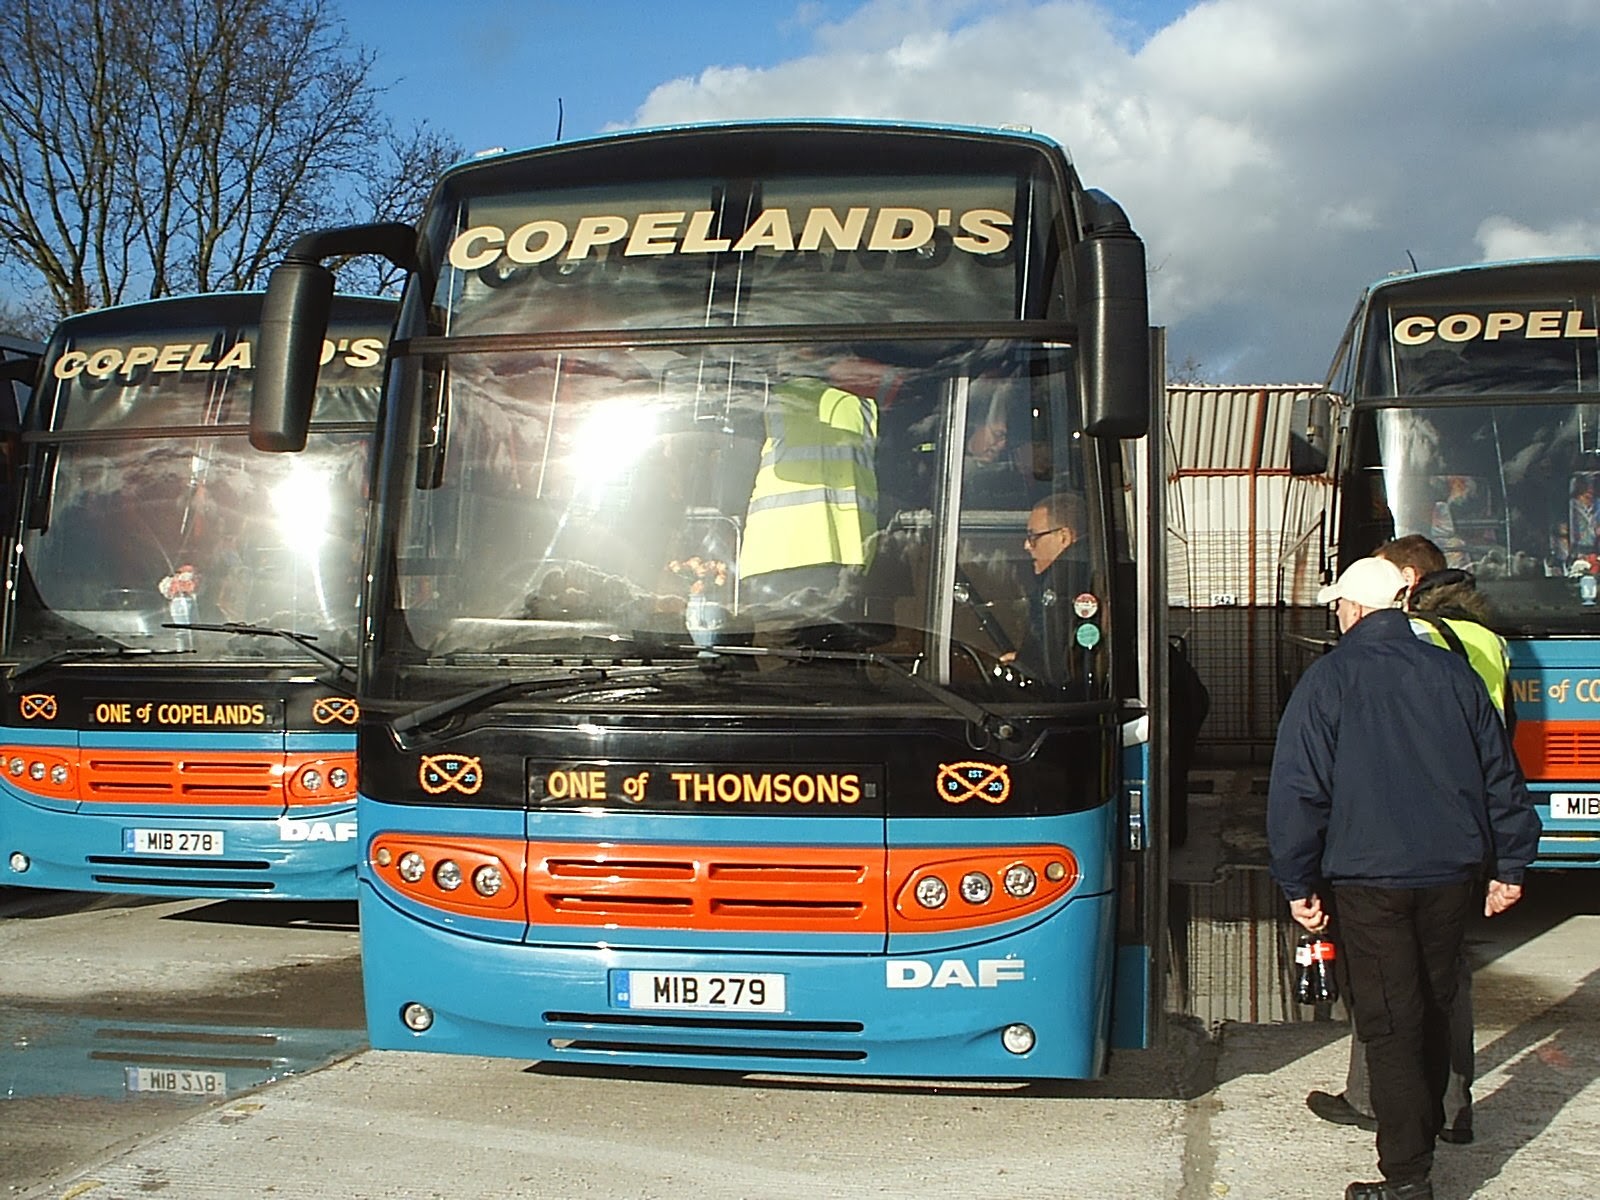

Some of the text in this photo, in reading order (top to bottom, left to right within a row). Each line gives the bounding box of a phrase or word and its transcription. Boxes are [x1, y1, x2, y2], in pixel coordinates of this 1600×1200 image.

[449, 207, 1014, 270] COPELAND'S
[53, 338, 384, 380] COPELA'S
[1547, 678, 1571, 704] of
[96, 703, 265, 724] ONE of COPELANDS
[548, 771, 860, 803] ONE of THOMSONS
[148, 832, 212, 851] MIB 278
[280, 822, 357, 841] DAF
[886, 959, 1025, 988] DAF
[653, 976, 766, 1006] MIB 279
